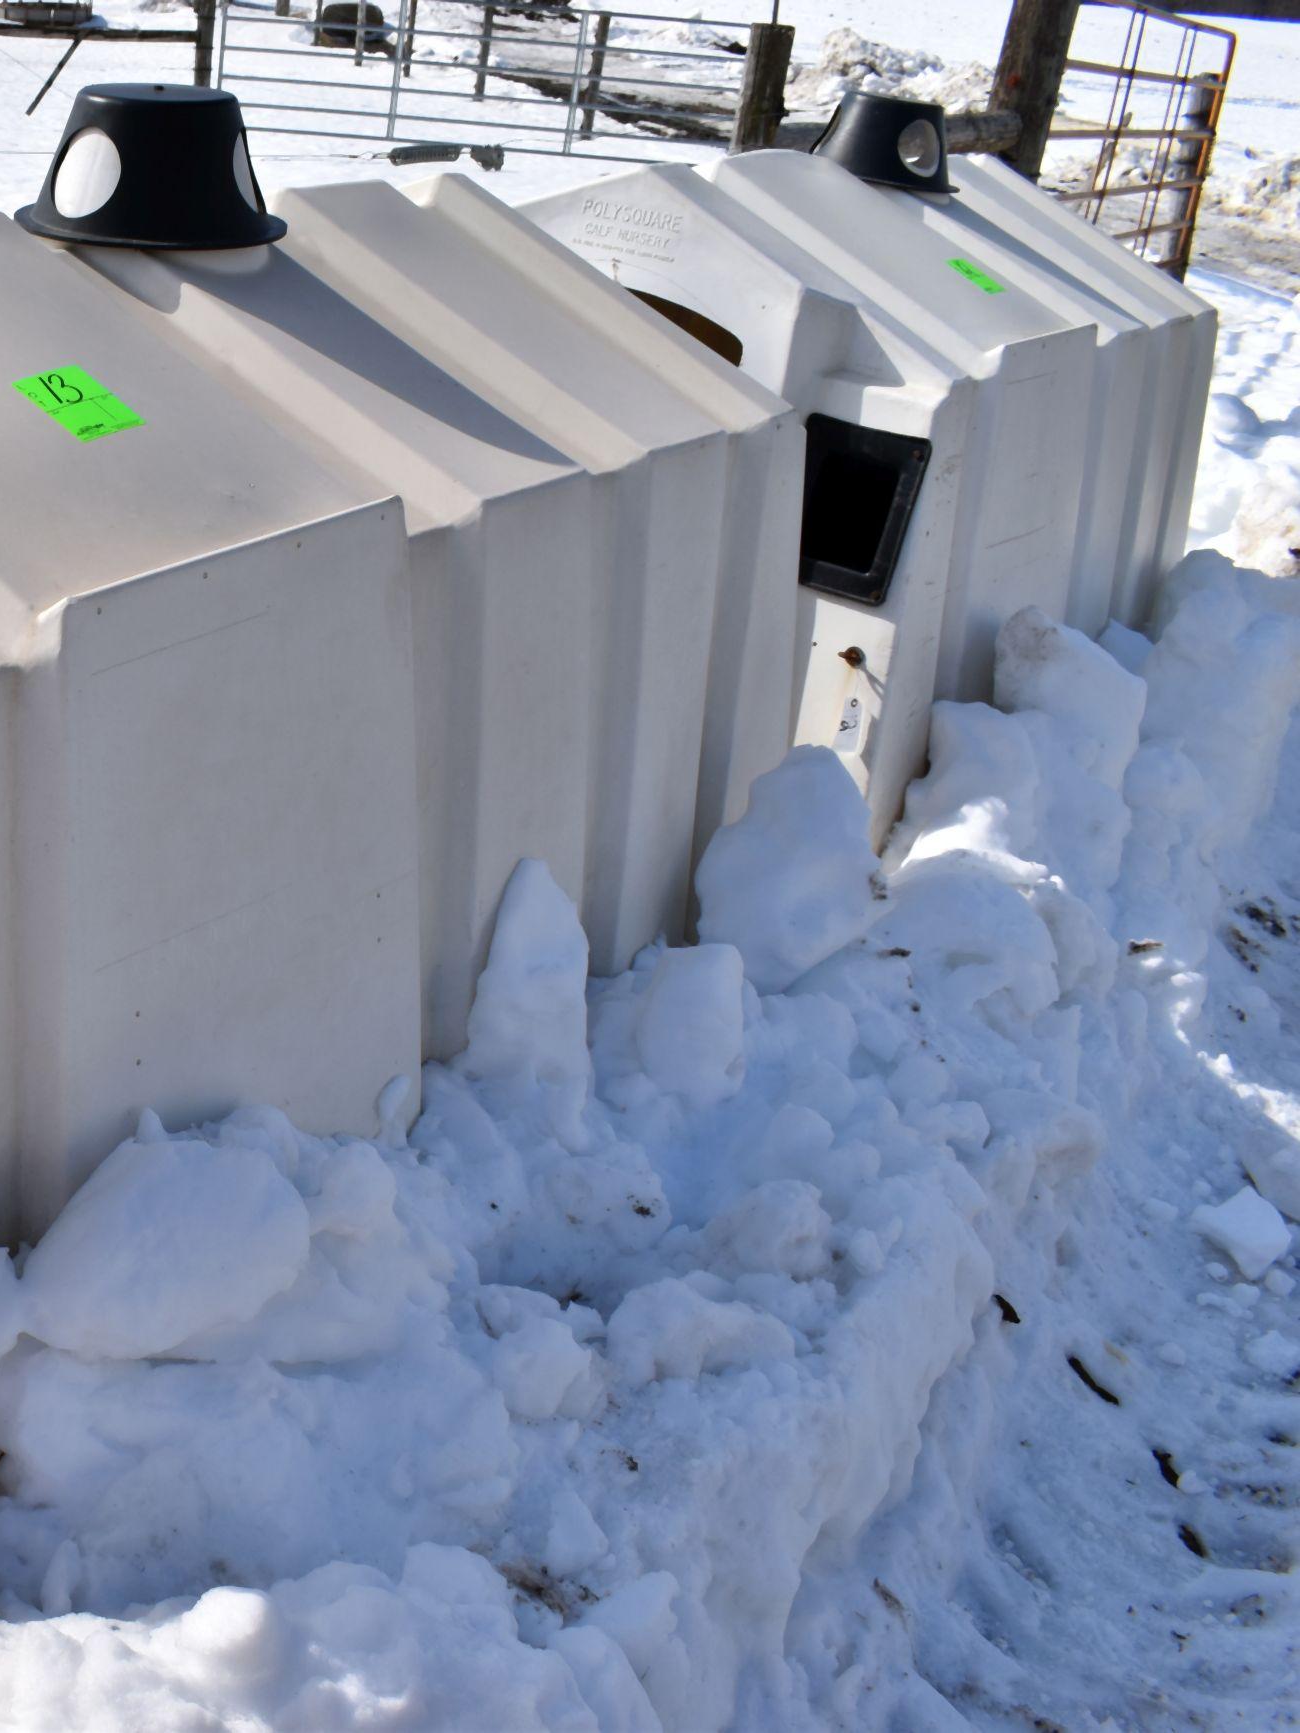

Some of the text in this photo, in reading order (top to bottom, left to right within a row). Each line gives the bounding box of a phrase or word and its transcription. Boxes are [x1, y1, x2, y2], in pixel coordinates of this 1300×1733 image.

[582, 199, 684, 234] POLYSQUARE
[584, 222, 671, 249] CALF NURSERY
[38, 373, 84, 405] 13
